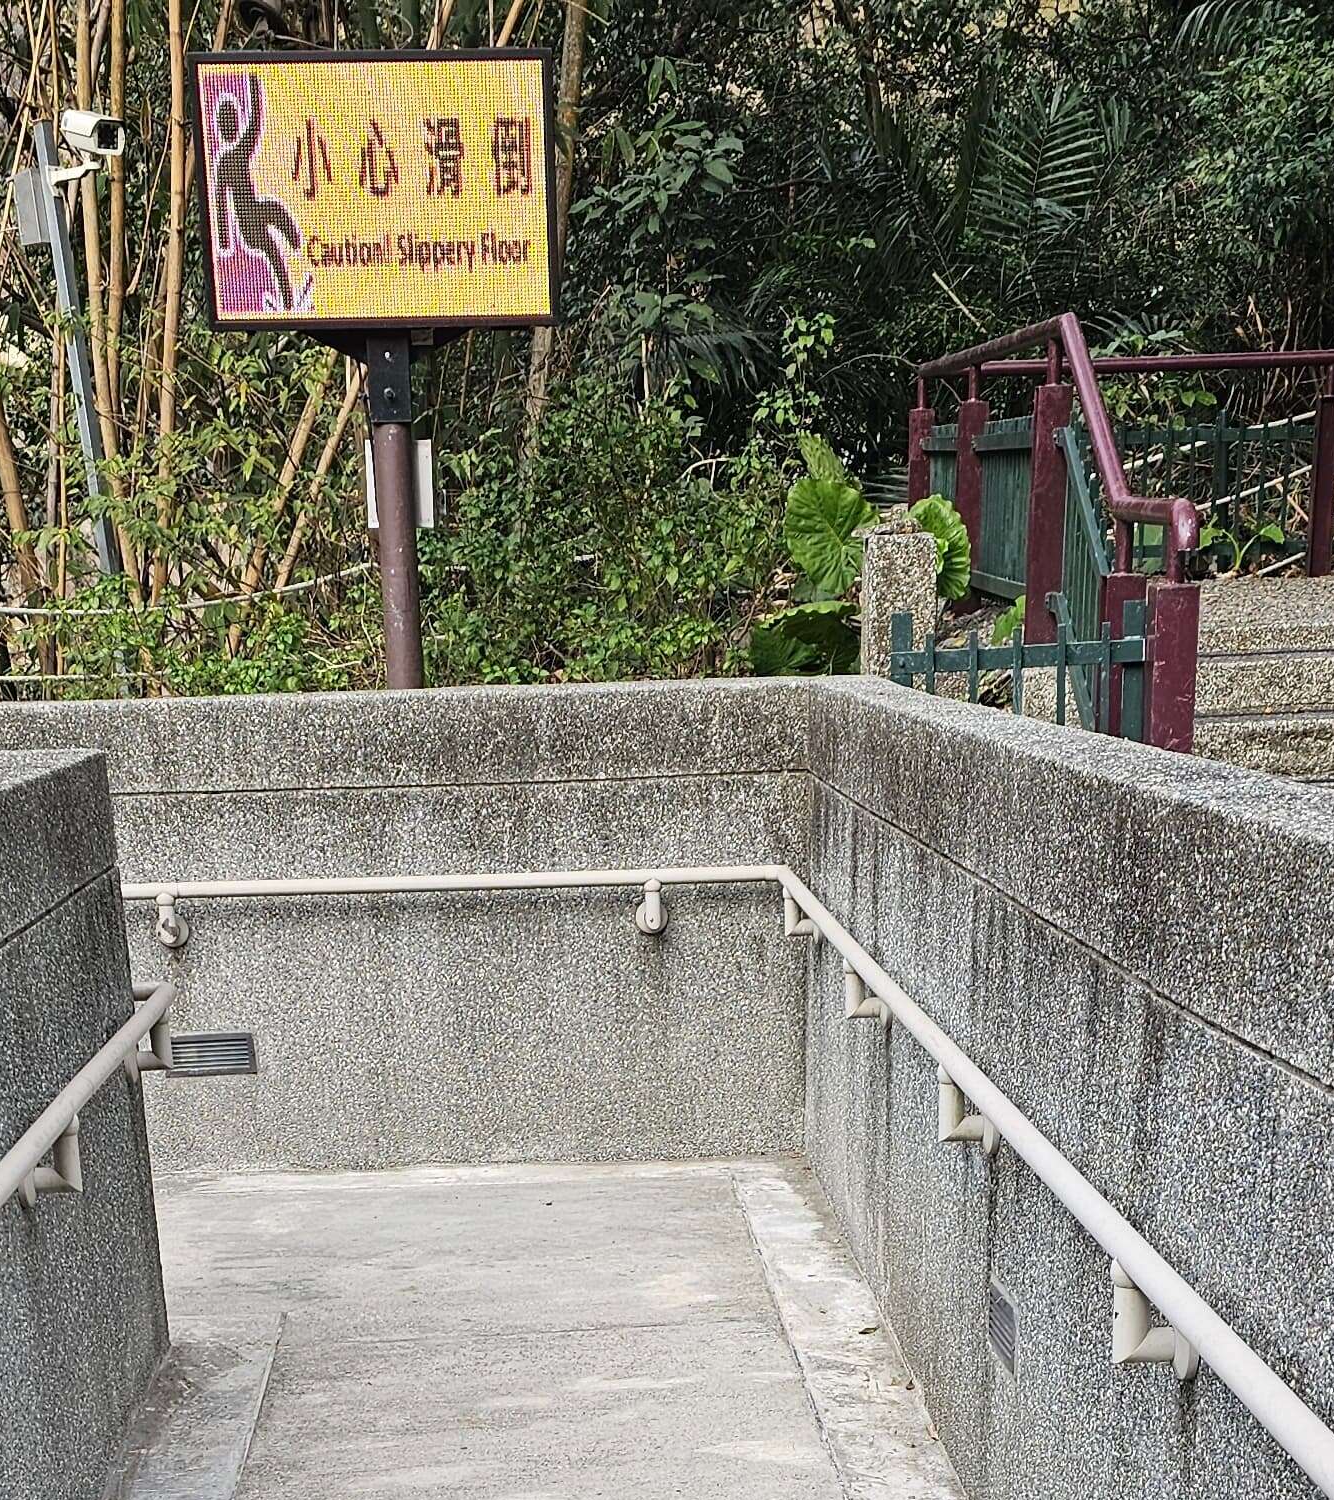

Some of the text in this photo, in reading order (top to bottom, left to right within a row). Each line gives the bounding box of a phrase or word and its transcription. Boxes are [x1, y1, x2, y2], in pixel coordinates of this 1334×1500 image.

[292, 115, 533, 200] 小心滑倒
[307, 228, 531, 272] Caution! Slippery Floor
